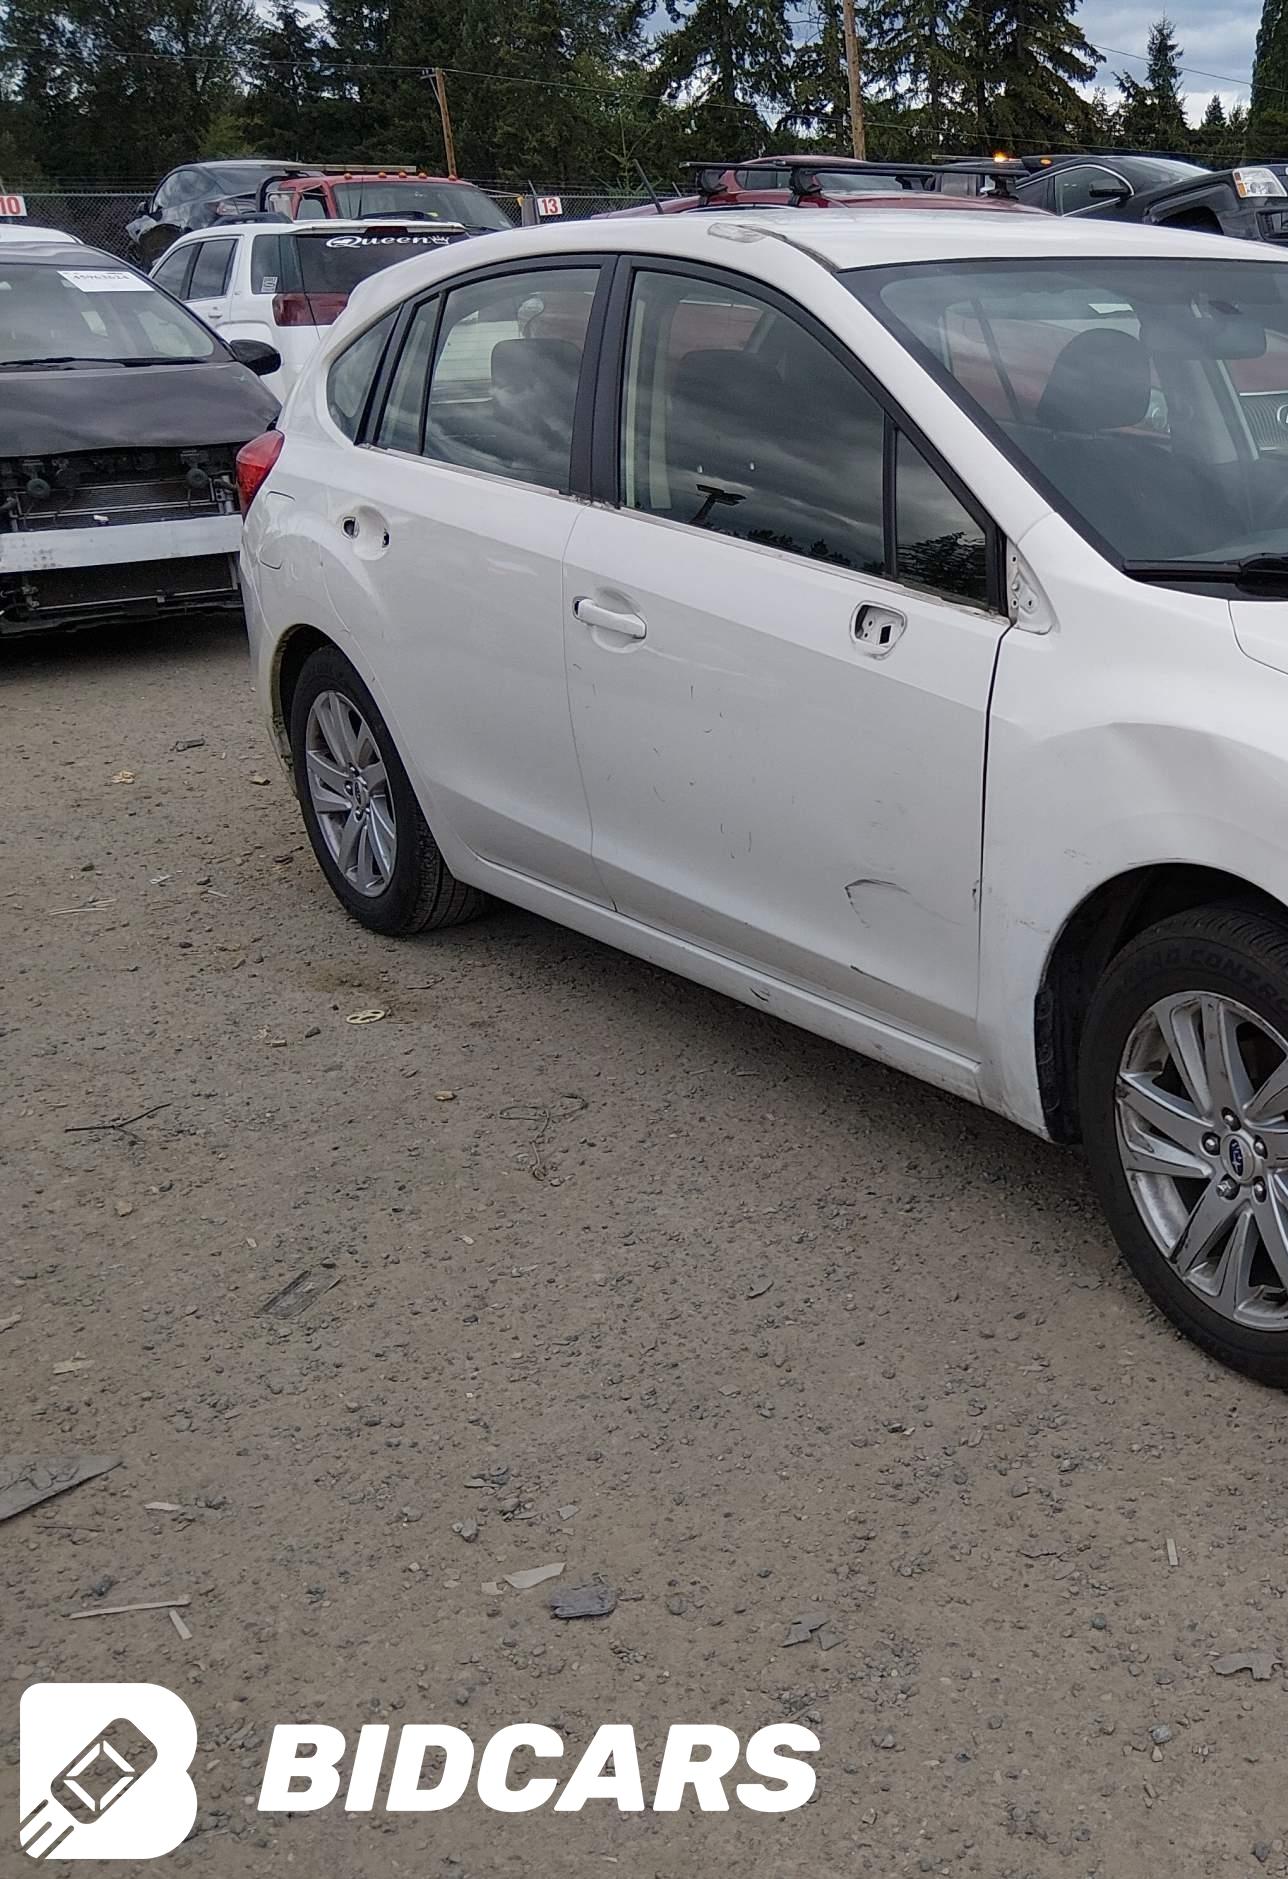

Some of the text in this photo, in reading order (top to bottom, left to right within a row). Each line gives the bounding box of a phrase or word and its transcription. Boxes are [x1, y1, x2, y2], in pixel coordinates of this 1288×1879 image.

[0, 196, 20, 215] 10
[542, 198, 559, 214] 13
[326, 235, 430, 249] Queen
